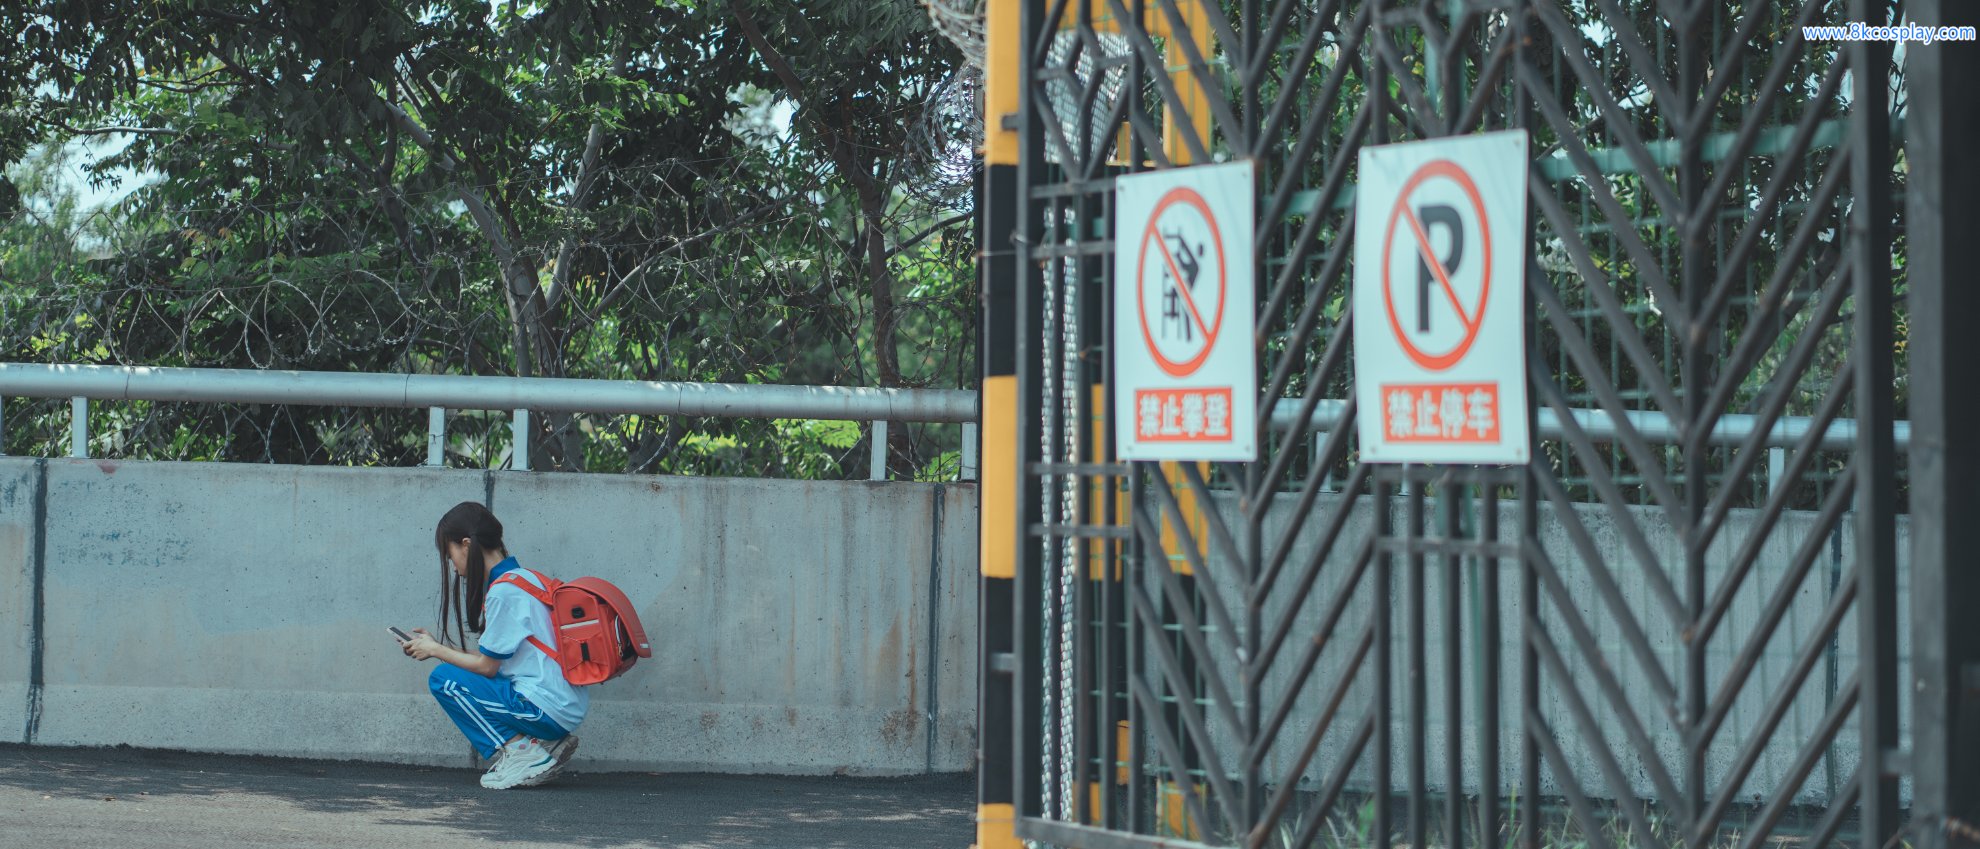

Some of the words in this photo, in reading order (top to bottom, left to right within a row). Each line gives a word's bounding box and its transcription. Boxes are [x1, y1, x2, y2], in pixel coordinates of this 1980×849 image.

[1418, 205, 1464, 332] P
[1139, 393, 1228, 437] 禁止攀登
[1388, 389, 1495, 438] 禁止停车
